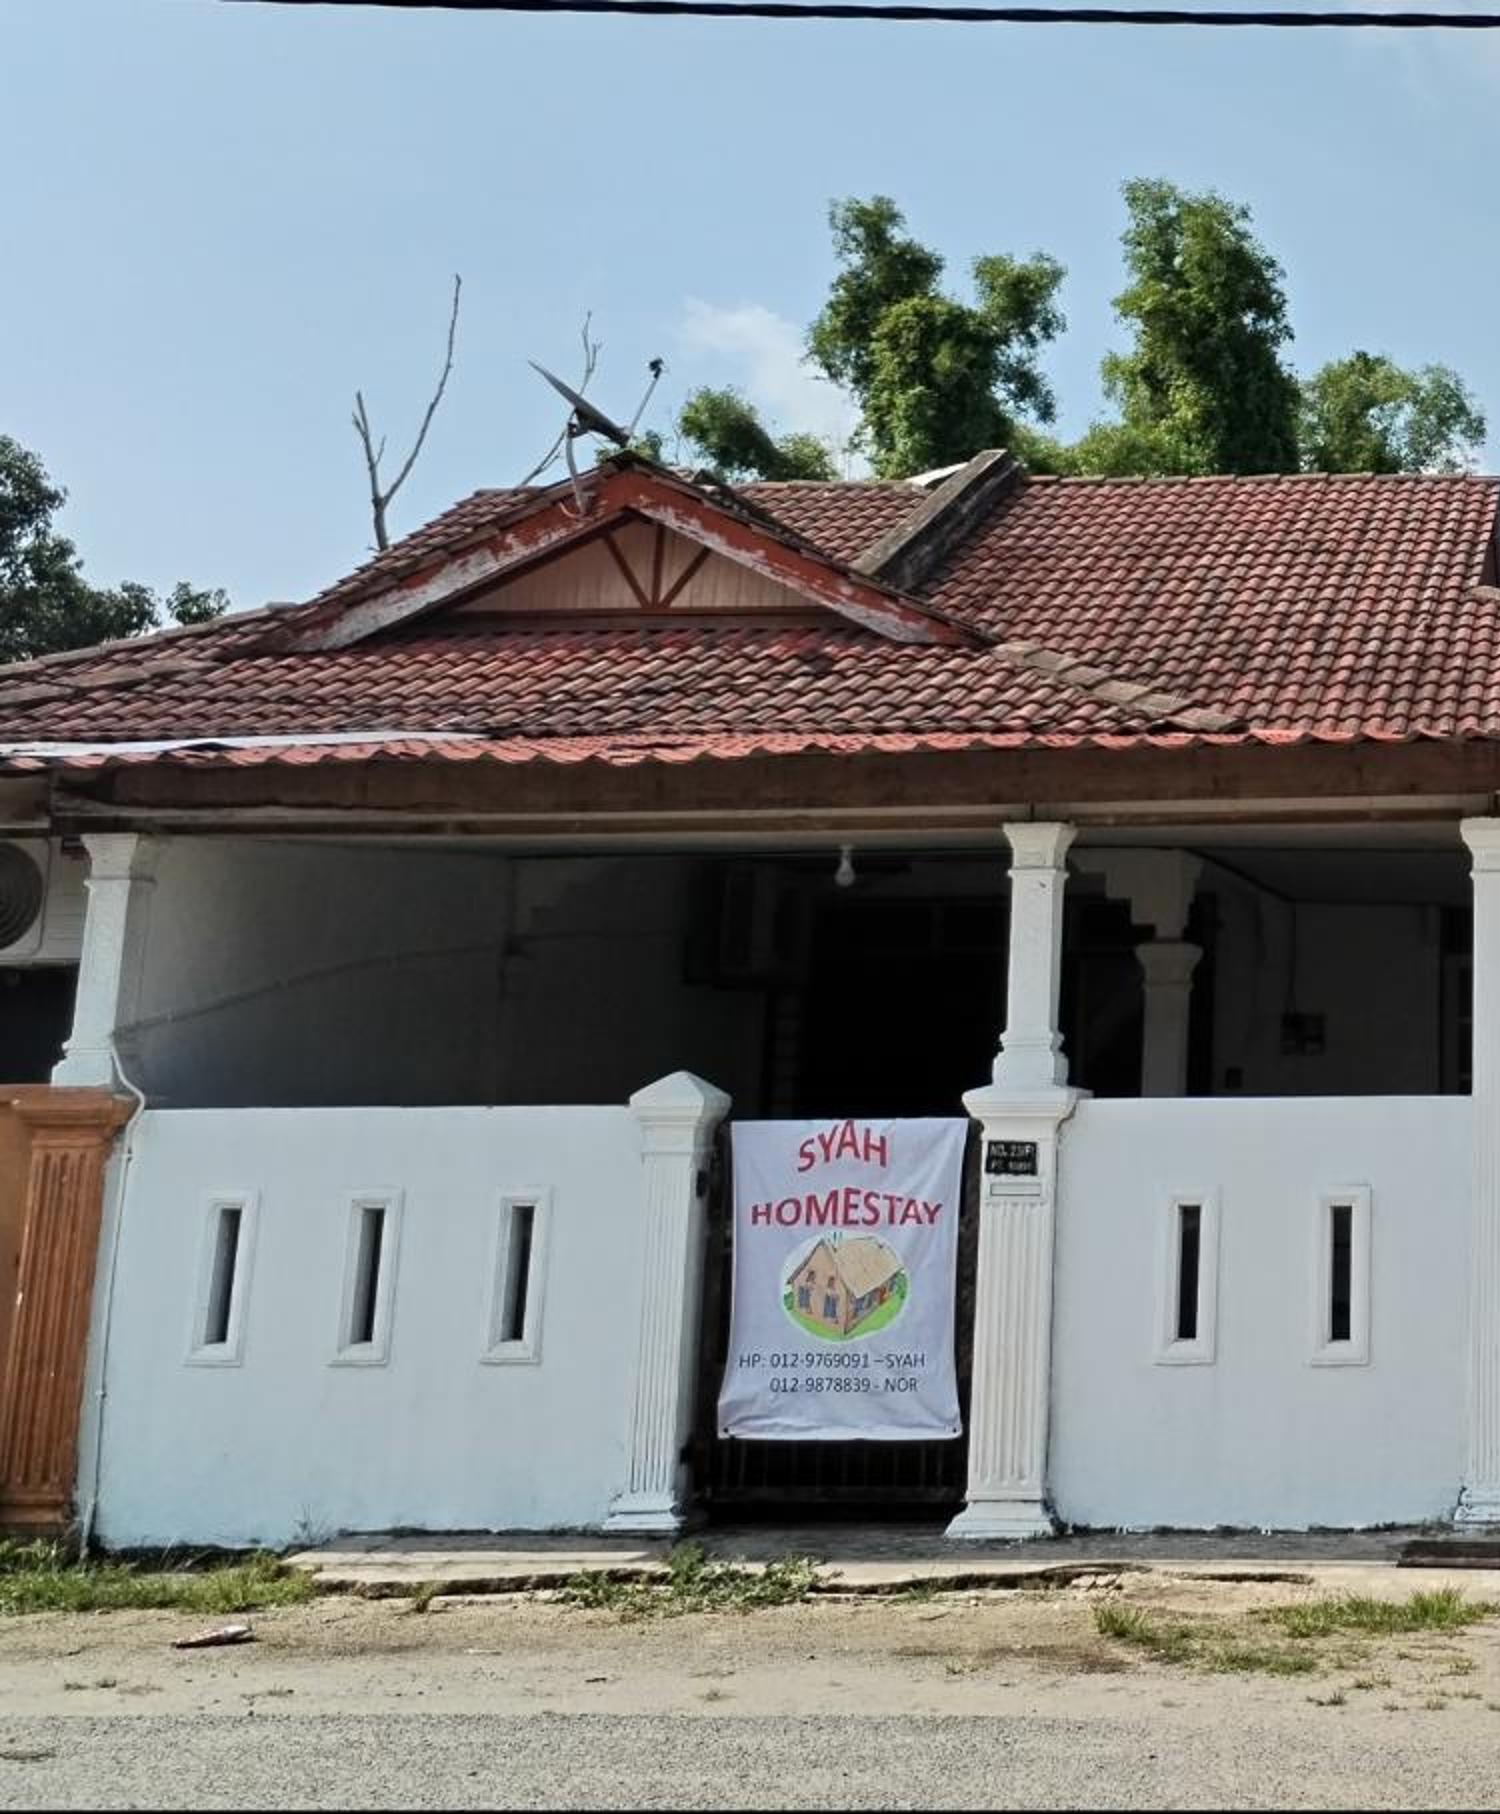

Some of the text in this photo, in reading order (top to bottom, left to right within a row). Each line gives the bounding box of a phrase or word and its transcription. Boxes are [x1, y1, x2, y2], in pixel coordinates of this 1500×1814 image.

[797, 1119, 888, 1172] SYAH
[751, 1187, 943, 1226] HOMESTAY
[739, 1354, 765, 1368] HP:
[769, 1353, 869, 1369] 012-9769091
[769, 1377, 871, 1393] 012-9878839
[884, 1378, 918, 1392] NOR
